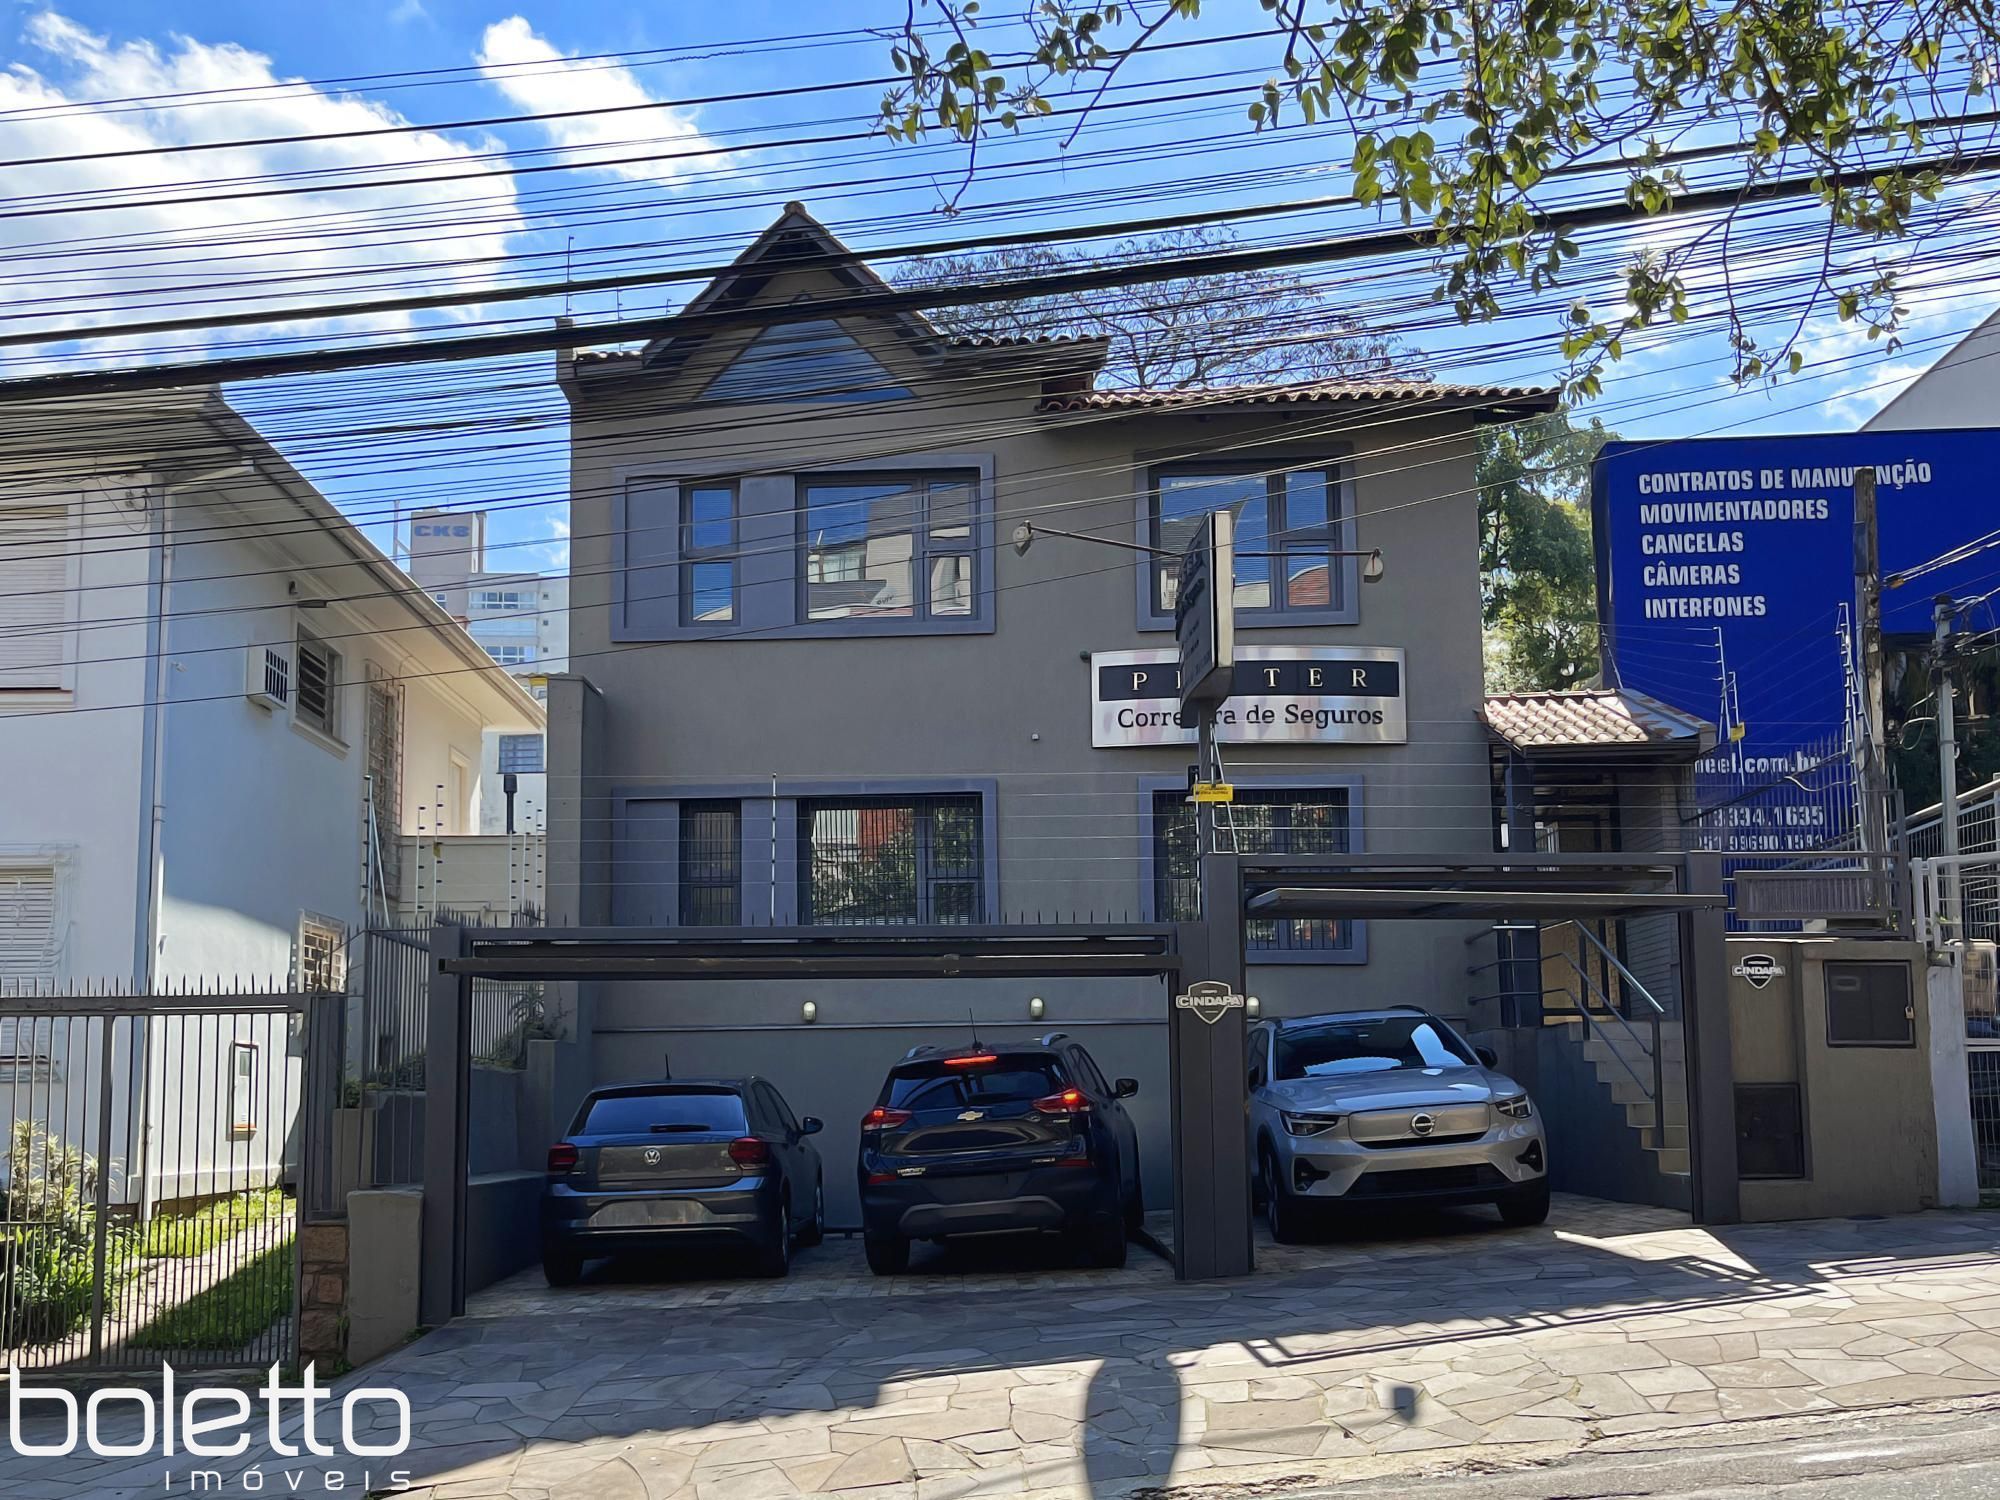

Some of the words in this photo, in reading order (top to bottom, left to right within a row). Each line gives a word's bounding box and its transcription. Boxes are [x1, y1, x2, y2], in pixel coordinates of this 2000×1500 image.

[1638, 470, 1753, 494] CONTRATOS
[1760, 469, 1784, 489] DE
[1791, 458, 1931, 490] MANUNÇÃO
[1640, 499, 1828, 524] MOVIMENTADORES
[1641, 532, 1744, 555] CANCELAS
[1643, 560, 1741, 586] CÂMERAS
[1645, 596, 1767, 618] INTERFONES
[1117, 707, 1236, 728] Correra
[1246, 705, 1275, 724] de
[1284, 703, 1383, 729] Seguros
[1733, 966, 1784, 975] CINDAPA
[1179, 996, 1241, 1006] CINDAPA
